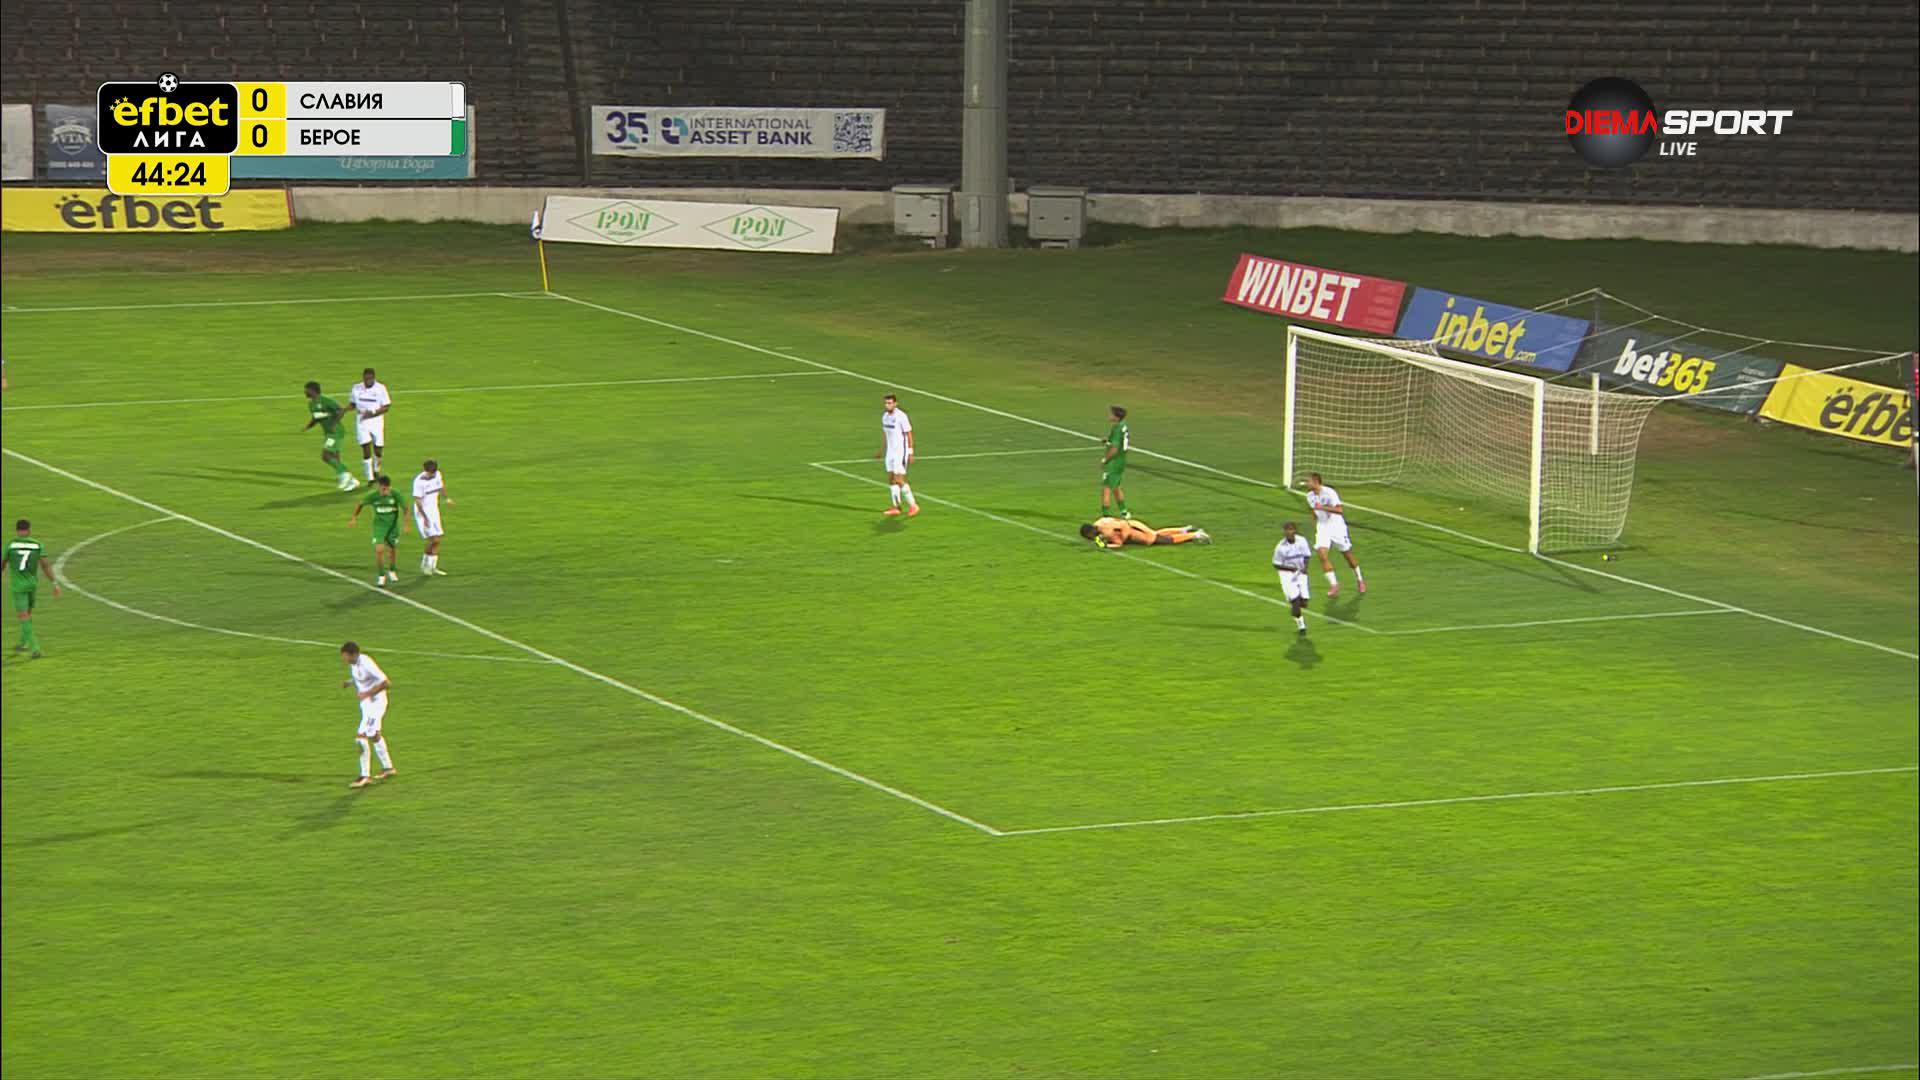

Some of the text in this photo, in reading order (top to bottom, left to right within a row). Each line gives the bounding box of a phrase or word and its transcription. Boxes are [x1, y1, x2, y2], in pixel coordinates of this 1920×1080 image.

[605, 111, 649, 145] 35
[690, 117, 813, 130] INTERNATIONAL
[690, 131, 813, 146] ASSET BANK
[58, 195, 225, 229] efbet
[1236, 258, 1361, 322] WINBET
[1432, 297, 1527, 359] inbet
[1612, 338, 1717, 394] bet365
[16, 550, 31, 571] 7
